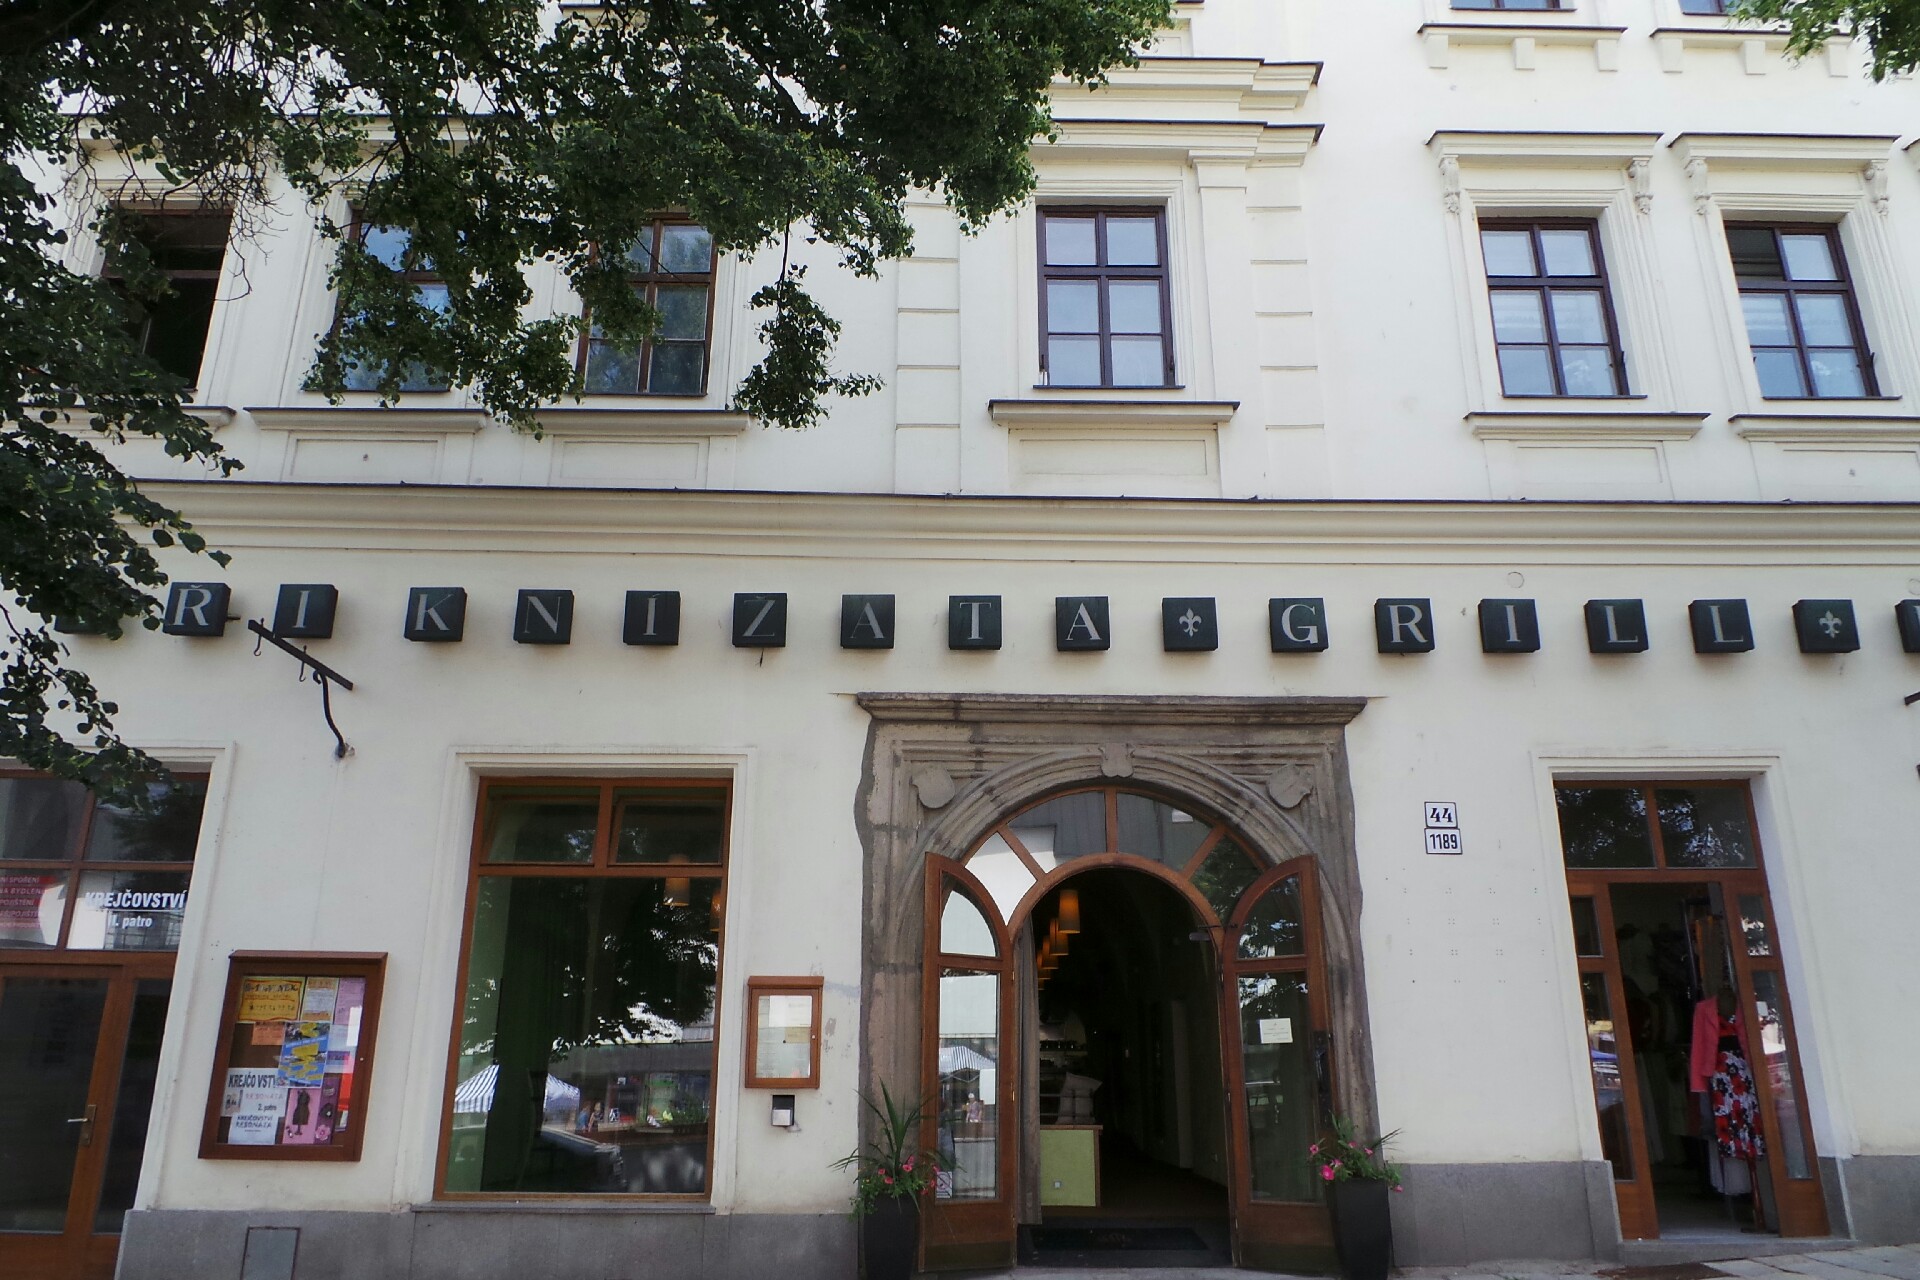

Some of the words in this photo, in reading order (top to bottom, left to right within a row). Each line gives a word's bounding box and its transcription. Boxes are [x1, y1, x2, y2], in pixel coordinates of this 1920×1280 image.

[414, 592, 1102, 642] KNÍŽATA
[1281, 602, 1745, 645] GRILL
[1430, 807, 1454, 823] 44
[1430, 833, 1459, 850] 1189
[84, 889, 188, 908] KREJČOVSTVÍ
[121, 915, 153, 930] patro
